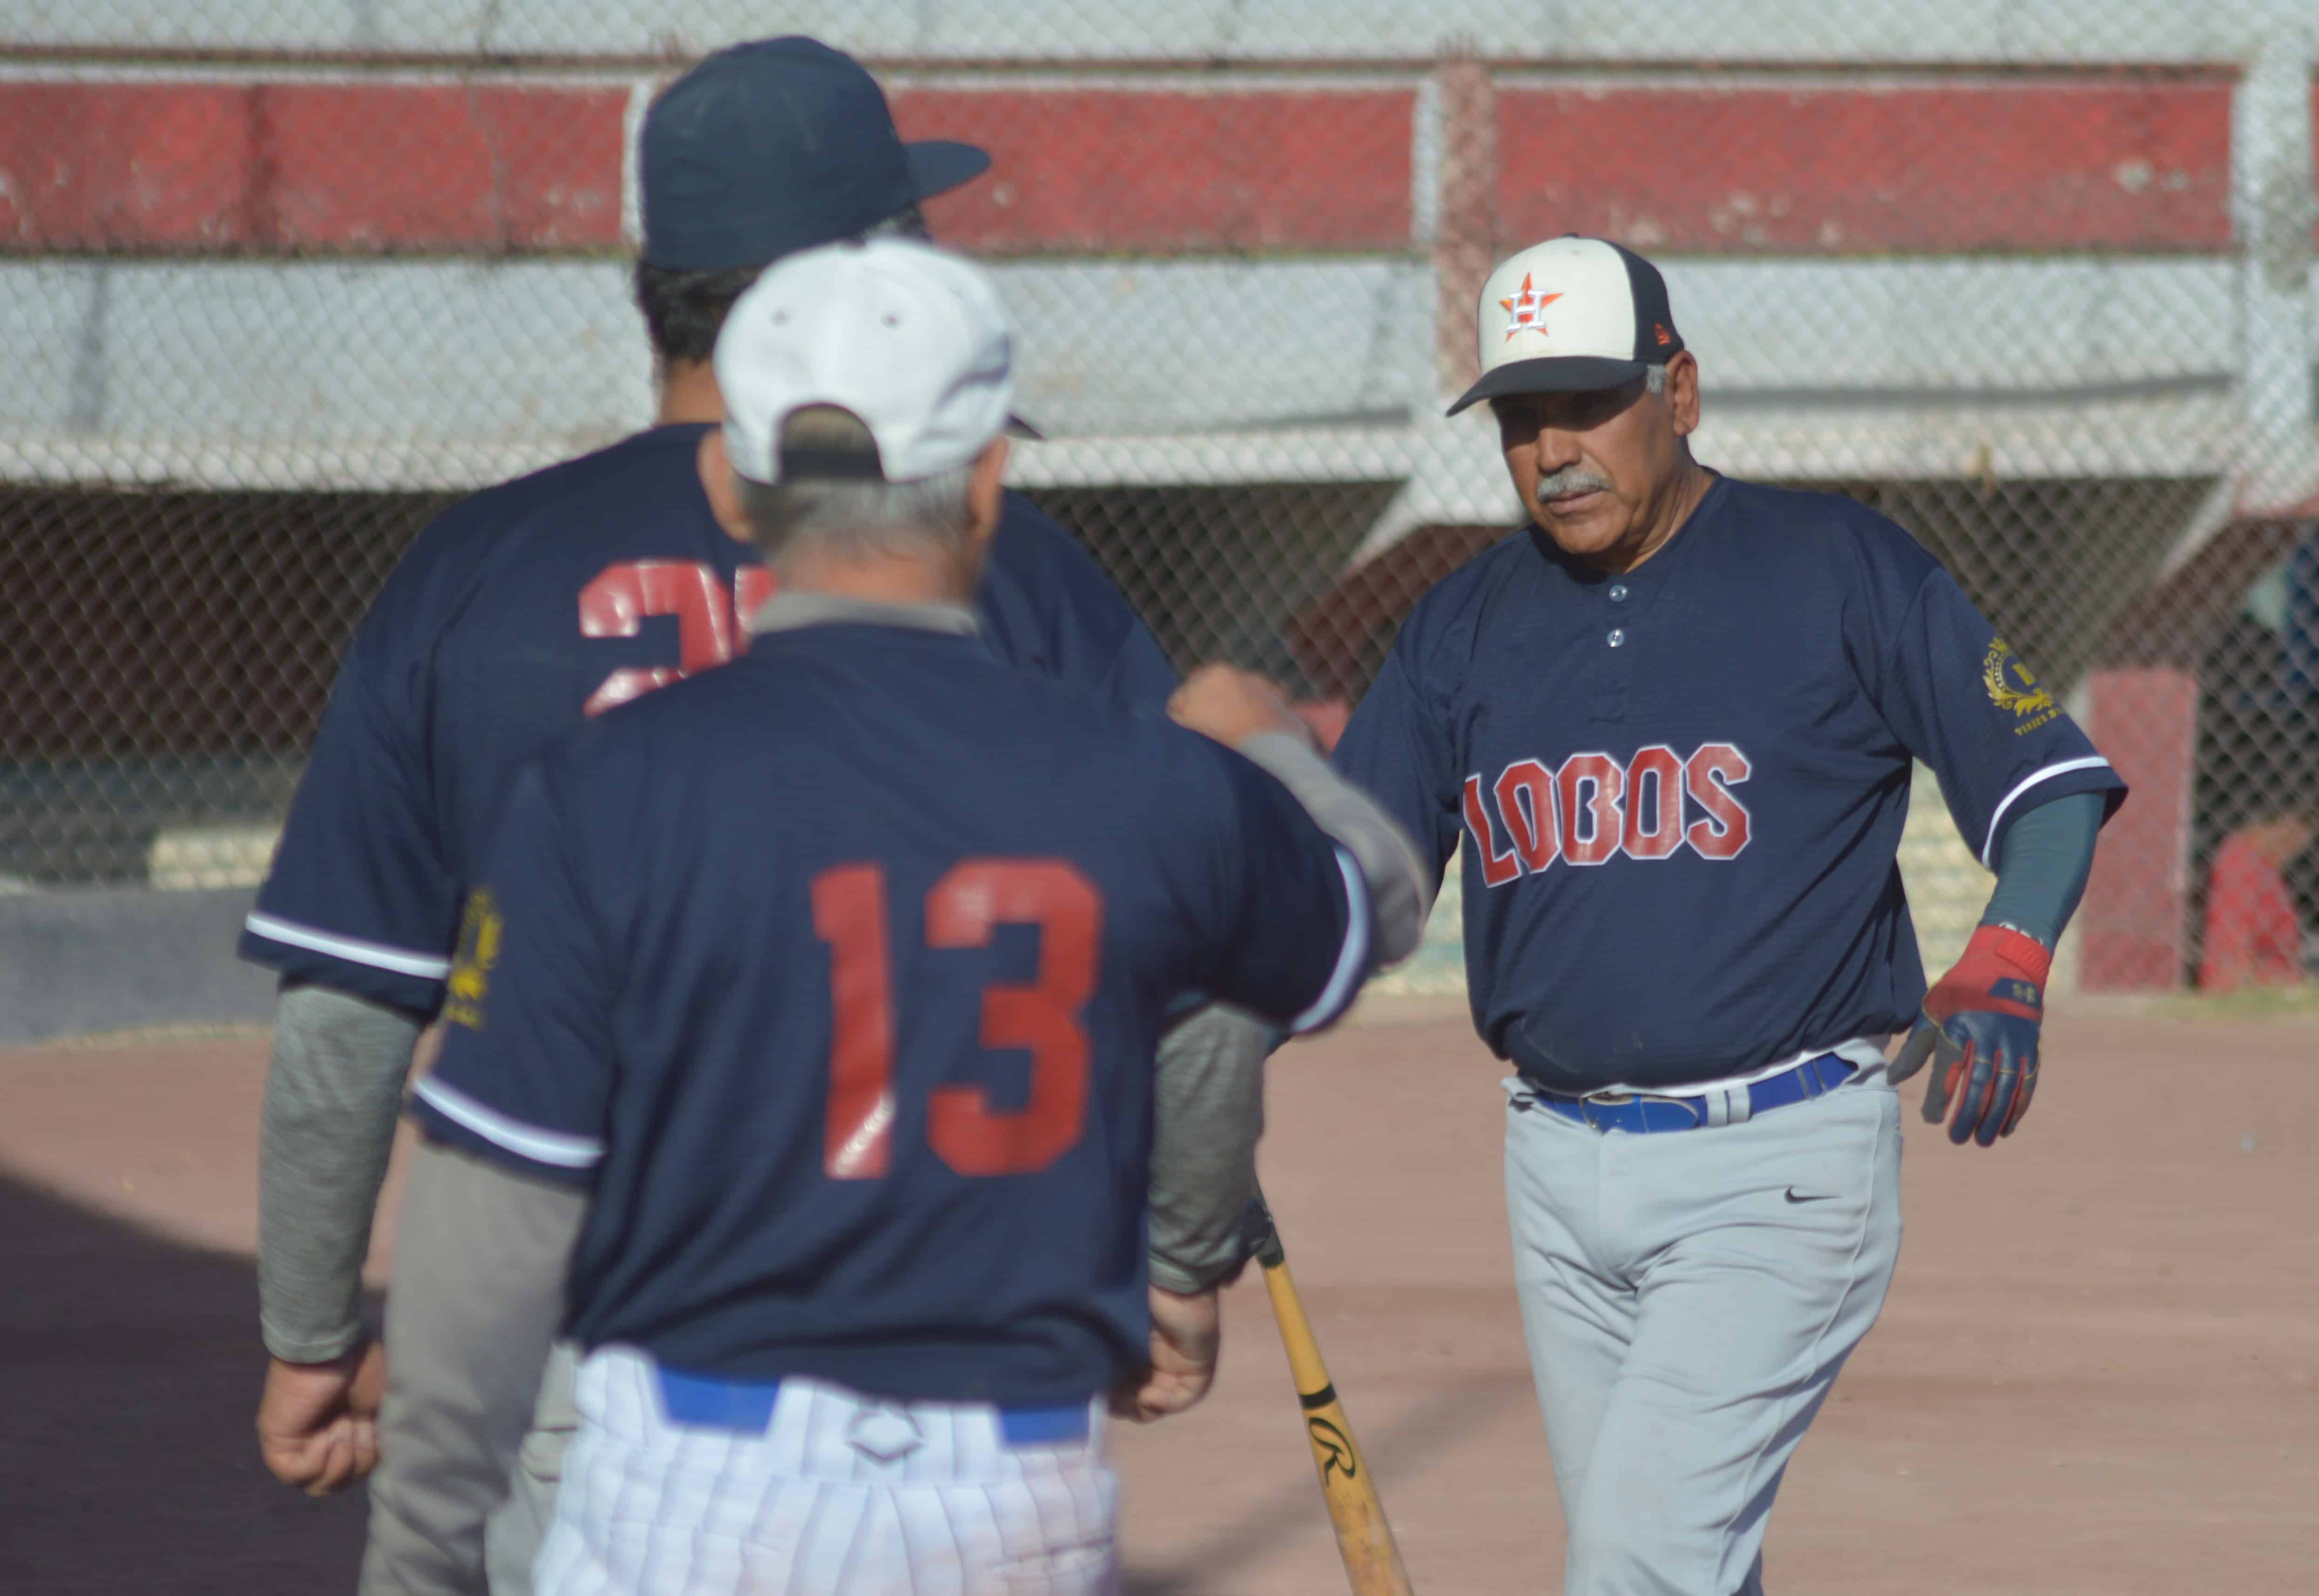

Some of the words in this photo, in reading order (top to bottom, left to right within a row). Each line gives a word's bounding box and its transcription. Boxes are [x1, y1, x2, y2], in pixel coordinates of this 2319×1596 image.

[1506, 289, 1546, 332] H
[1463, 743, 1751, 887] LOBOS
[809, 858, 1104, 1180] 13
